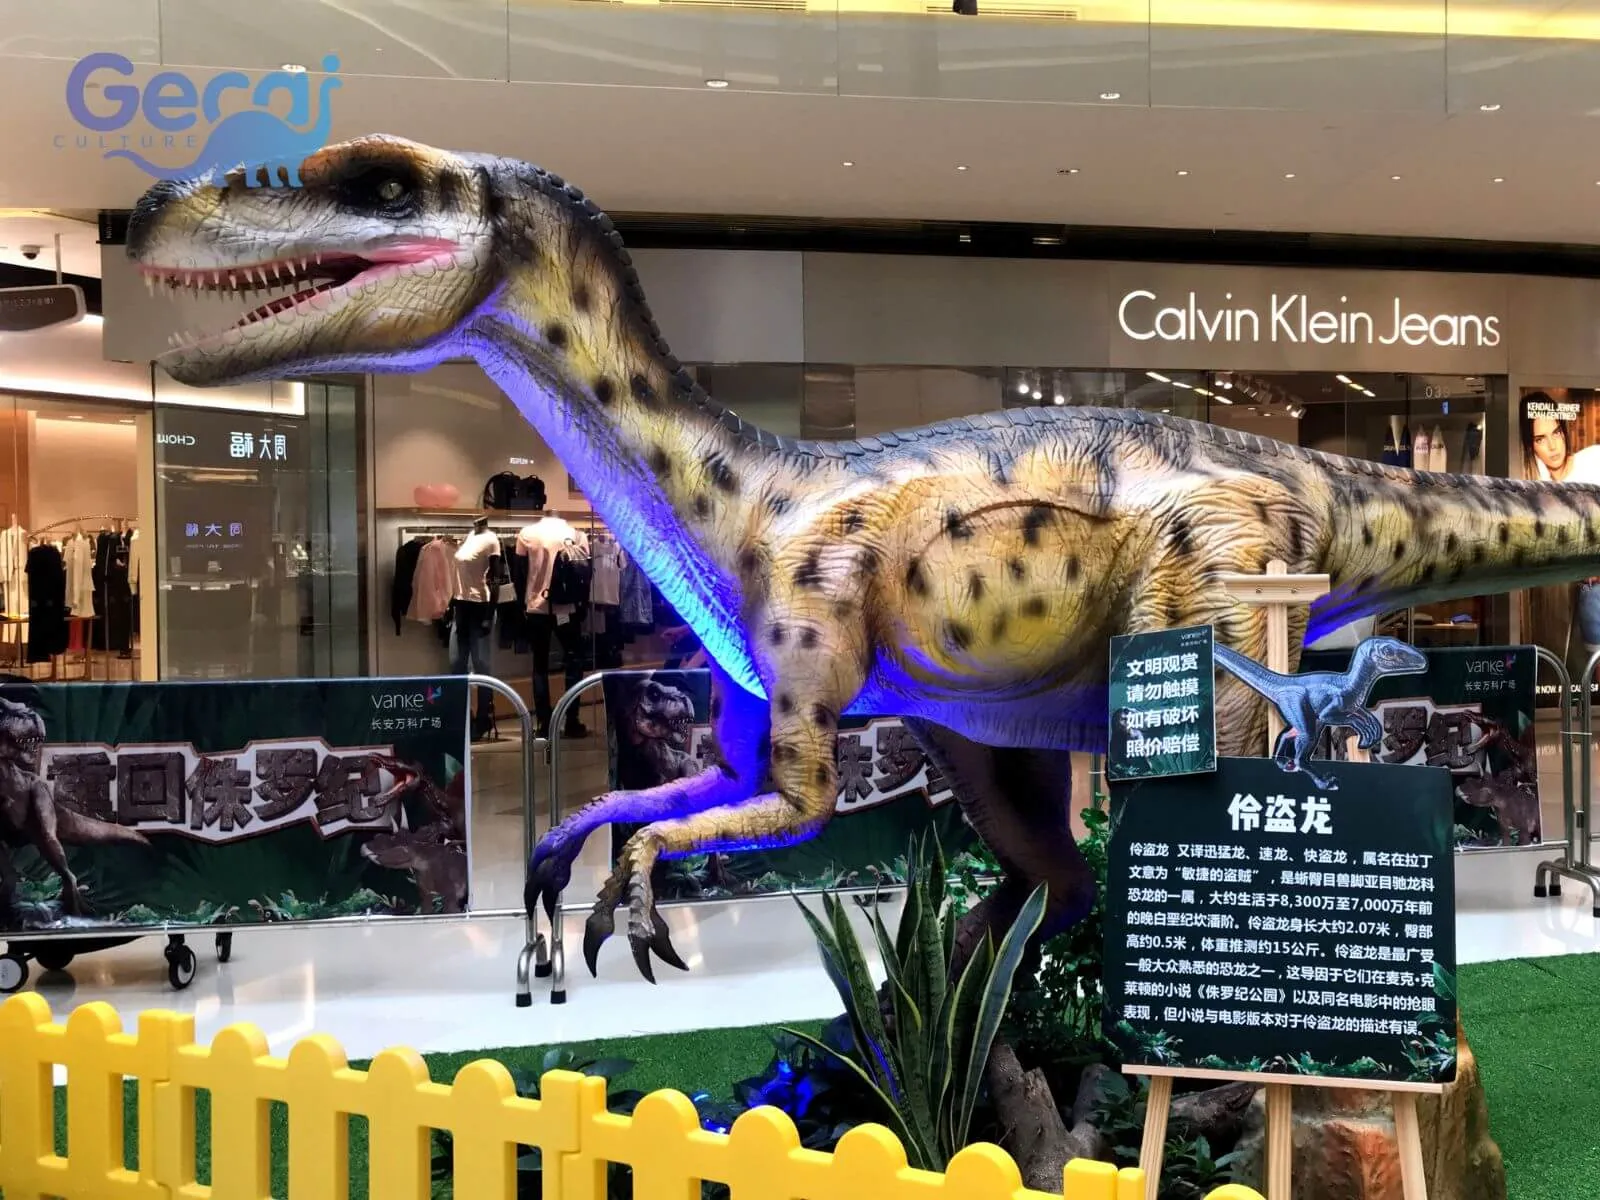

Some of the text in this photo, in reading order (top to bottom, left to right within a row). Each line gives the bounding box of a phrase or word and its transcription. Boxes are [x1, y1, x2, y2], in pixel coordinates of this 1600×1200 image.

[1118, 290, 1501, 346] Calvin Klein Jeans
[1126, 652, 1199, 678] 文明观赏
[1465, 657, 1505, 673] vanke
[371, 693, 424, 709] vanke
[1126, 677, 1200, 703] 请勿触摸
[371, 717, 442, 730] 长安万科广场
[1126, 705, 1200, 730] 如有破坏
[1126, 733, 1200, 759] 照价赔偿
[1227, 793, 1333, 835] 伶盗龙
